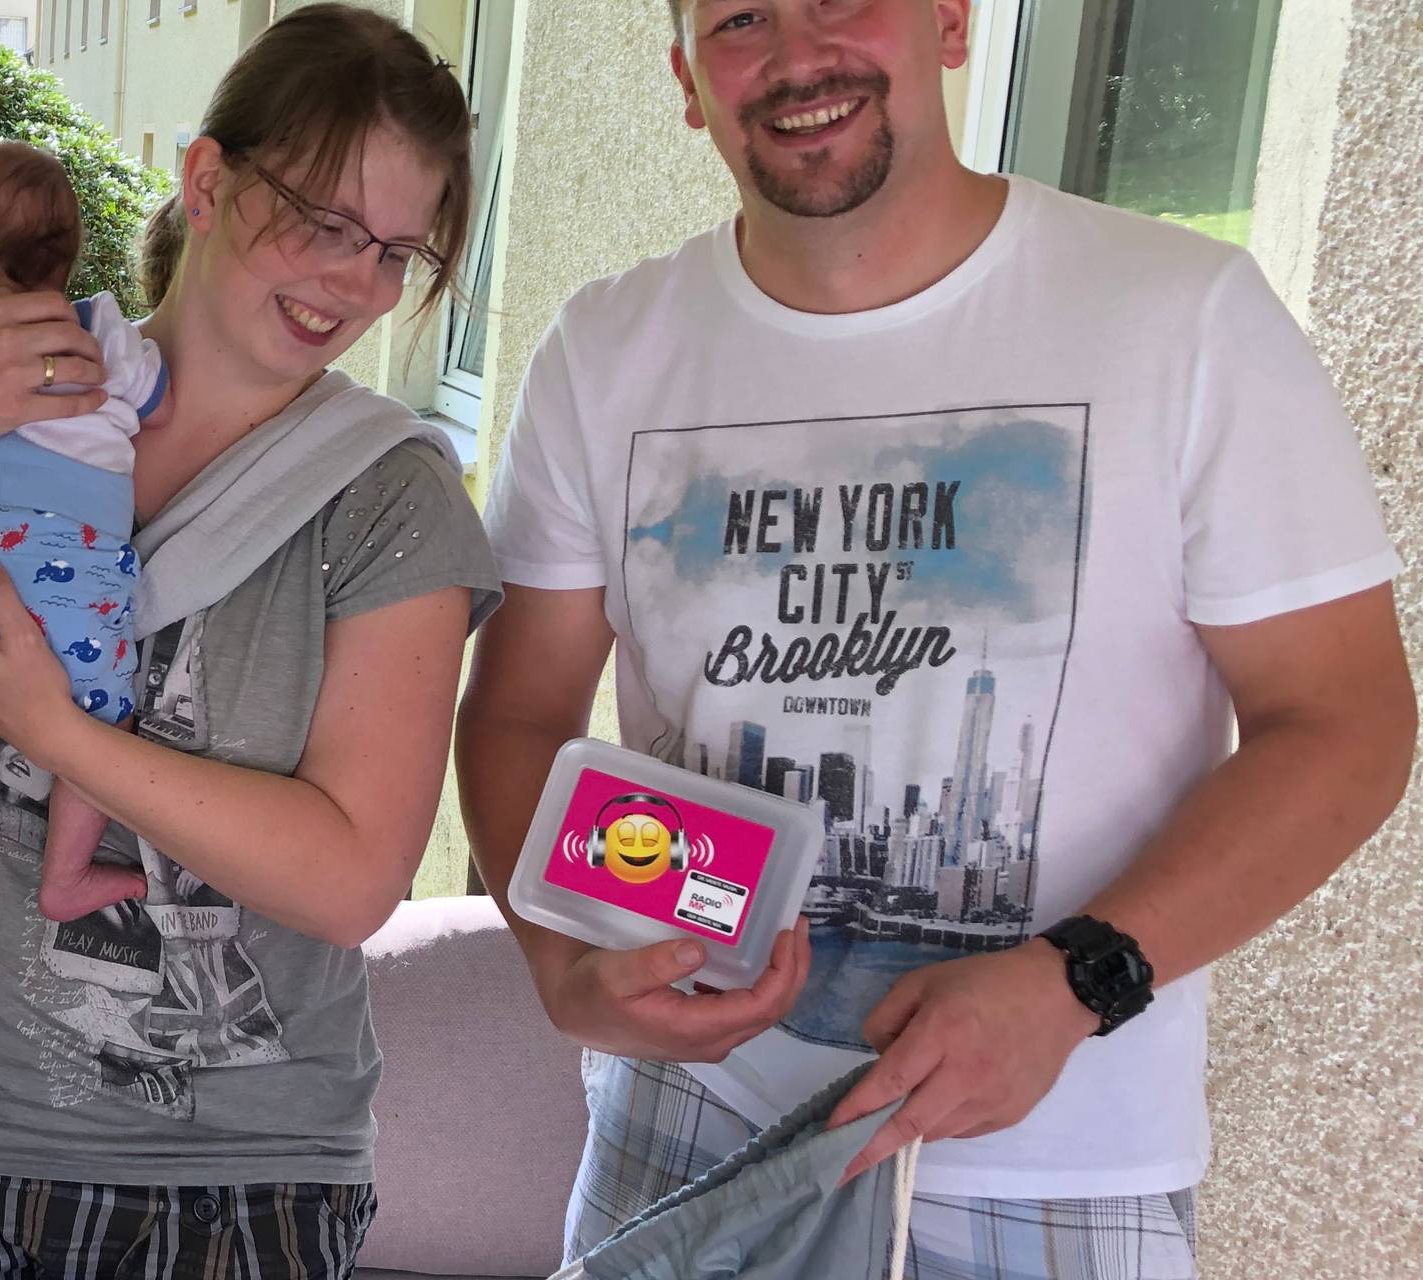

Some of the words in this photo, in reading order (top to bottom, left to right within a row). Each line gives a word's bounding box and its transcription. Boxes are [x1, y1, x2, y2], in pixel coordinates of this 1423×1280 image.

[723, 487, 823, 555] NEW
[839, 480, 961, 552] YORK
[778, 562, 891, 624] CITY
[703, 610, 956, 696] Brooklyn
[783, 696, 872, 717] DOWNTOWN
[688, 900, 706, 912] MK
[691, 892, 722, 909] RADIO
[160, 911, 177, 933] IN
[188, 911, 219, 932] BAND
[60, 930, 95, 951] PLAY
[98, 943, 144, 967] MUSIC
